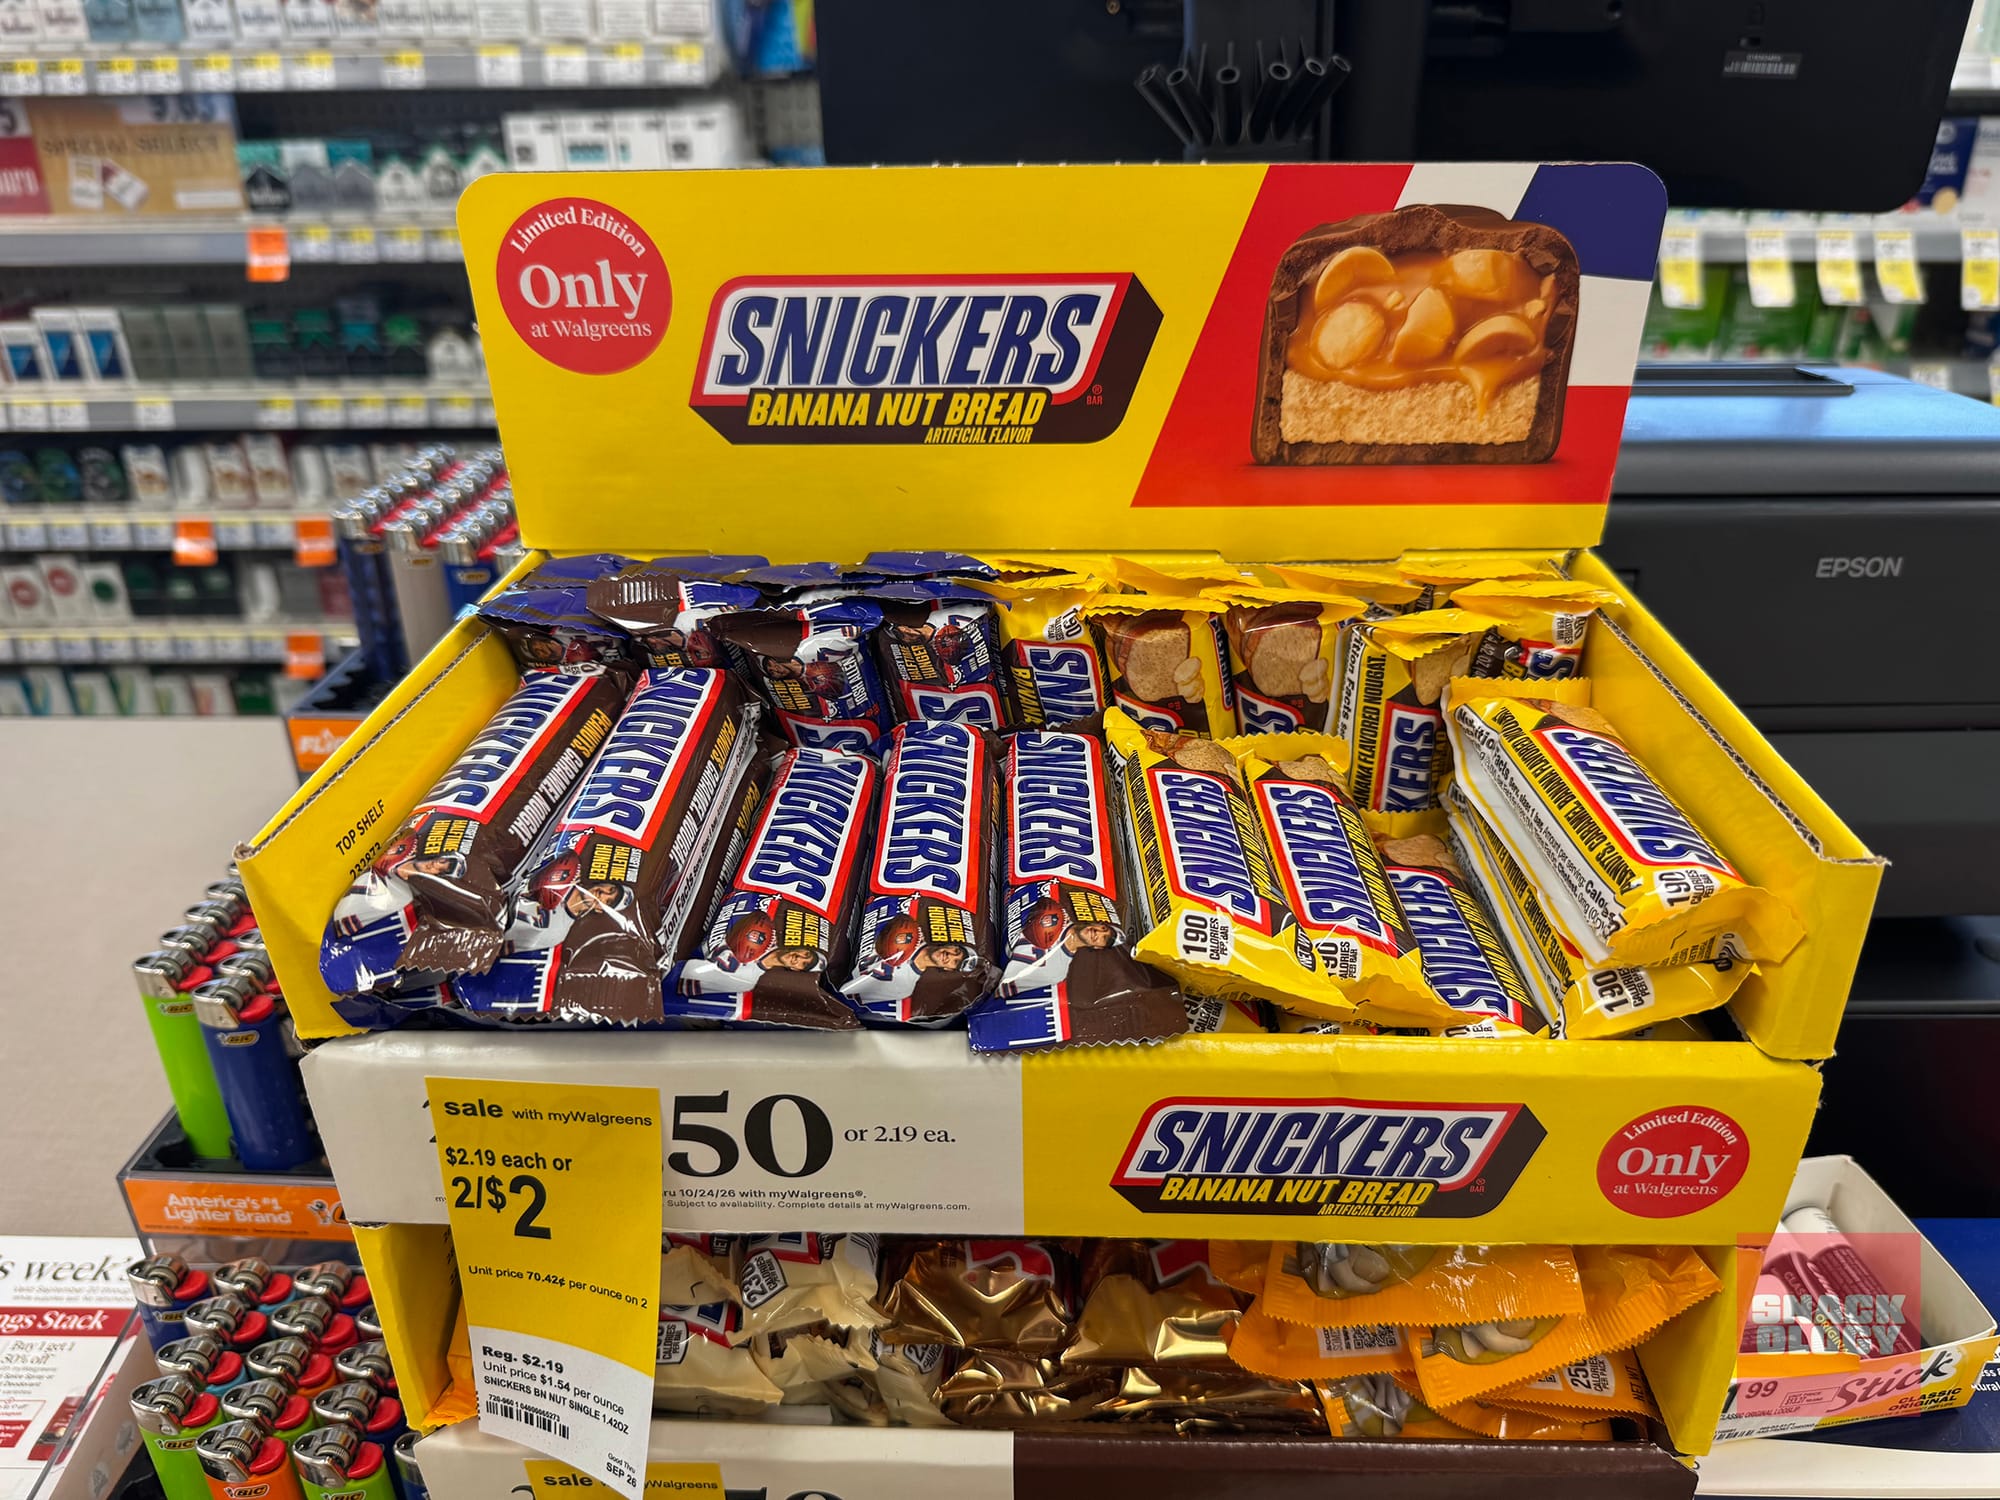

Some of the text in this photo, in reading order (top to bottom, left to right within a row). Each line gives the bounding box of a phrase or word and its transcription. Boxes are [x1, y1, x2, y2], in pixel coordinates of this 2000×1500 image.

[510, 206, 647, 258] Limited Edition
[520, 259, 648, 320] Only
[531, 319, 652, 342] at Walgreens
[719, 293, 1101, 388] SNICKERS
[748, 393, 1047, 426] BANANA NUT BREAD
[924, 427, 1034, 444] ARTIFICIAL FLAVOR
[1815, 557, 1903, 578] EPSON
[1062, 607, 1082, 638] 190
[900, 644, 923, 681] HALFTIME
[911, 644, 938, 680] HUNGER
[974, 645, 990, 667] JOSH
[1012, 667, 1044, 725] BANANA
[1359, 653, 1387, 764] FLAVORED NOUGAT.
[423, 672, 580, 806] SNICKERS
[567, 667, 712, 832] SNICKERS
[1511, 733, 1552, 782] FLAVORED
[883, 720, 969, 895] SNICKERS
[1016, 732, 1098, 880] SNICKERS
[1538, 770, 1577, 810] BANANA
[1551, 731, 1727, 870] SNICKERS
[335, 799, 385, 856] TOP SHELF
[424, 820, 452, 855] HUNGER
[442, 819, 469, 853] HALFTIME
[1564, 800, 1608, 851] CARAMEL.
[588, 843, 614, 881] HUNGER
[1161, 773, 1256, 916] SNICKERS
[1270, 786, 1382, 937] SNICKERS
[609, 845, 631, 882] HALFTIME
[1337, 804, 1404, 932] BANANA NUT BREAD
[675, 872, 695, 916] Facts
[1068, 891, 1095, 922] HUNGER
[1086, 891, 1111, 924] HALFTIME
[1658, 871, 1691, 908] 190
[784, 909, 804, 946] HUNGER
[803, 912, 820, 949] HALFTIME
[863, 909, 879, 930] JOSH
[927, 906, 949, 942] HUNGER
[945, 907, 966, 943] HALFTIME
[1182, 914, 1209, 955] 190
[1470, 921, 1502, 951] NUT
[1209, 917, 1220, 961] CALORIES
[1388, 873, 1508, 1018] SNICKERS
[1487, 948, 1533, 1008] BANANA
[1592, 970, 1630, 1013] 190
[444, 1098, 653, 1127] sale with myWalgreens
[1622, 1110, 1738, 1145] Limited Edition
[844, 1128, 869, 1143] or
[874, 1126, 918, 1143] 2.19
[923, 1130, 957, 1143] ea.
[1136, 1109, 1495, 1179] SNICKERS
[445, 1146, 573, 1172] $2.19 each or
[1617, 1145, 1732, 1185] Only
[167, 1193, 283, 1211] America's #1
[451, 1174, 552, 1240] 2/$2
[667, 1199, 705, 1209] Subject
[720, 1200, 775, 1210] availability.
[777, 1201, 826, 1211] Complete
[828, 1201, 862, 1210] details
[864, 1202, 874, 1210] at
[876, 1202, 971, 1212] myWalgreens.com.
[679, 1188, 736, 1198] 10/24/26
[739, 1189, 766, 1198] with
[1159, 1178, 1437, 1205] BANANA NUT BREAD
[1613, 1182, 1719, 1198] at Walgreens
[164, 1205, 294, 1224] Lighter Brand
[1317, 1204, 1420, 1218] ARTIFICIAL FLAVOR
[468, 1265, 648, 1309] Unit price 70.42¢ per ounce on 2
[755, 1254, 776, 1291] CALORIES
[37, 1310, 109, 1330] Stack
[482, 1346, 564, 1374] Reg. $2.19
[662, 1324, 677, 1360] CALORIES
[482, 1360, 625, 1415] Unit price $1.54 per ounce
[484, 1375, 532, 1395] SNICKERS
[533, 1387, 547, 1400] BN
[549, 1392, 568, 1407] NUT
[568, 1399, 600, 1421] SINGLE
[1624, 1364, 1645, 1402] NET WT
[1745, 1380, 1778, 1400] 99
[1825, 1350, 1953, 1414] Stick
[1898, 1387, 1962, 1404] CLASSIC
[1887, 1395, 1957, 1412] ORIGINAL
[543, 1473, 593, 1487] sale
[606, 1462, 637, 1488] SEP 26
[607, 1452, 636, 1474] Good Thru
[235, 1485, 267, 1497] BIC
